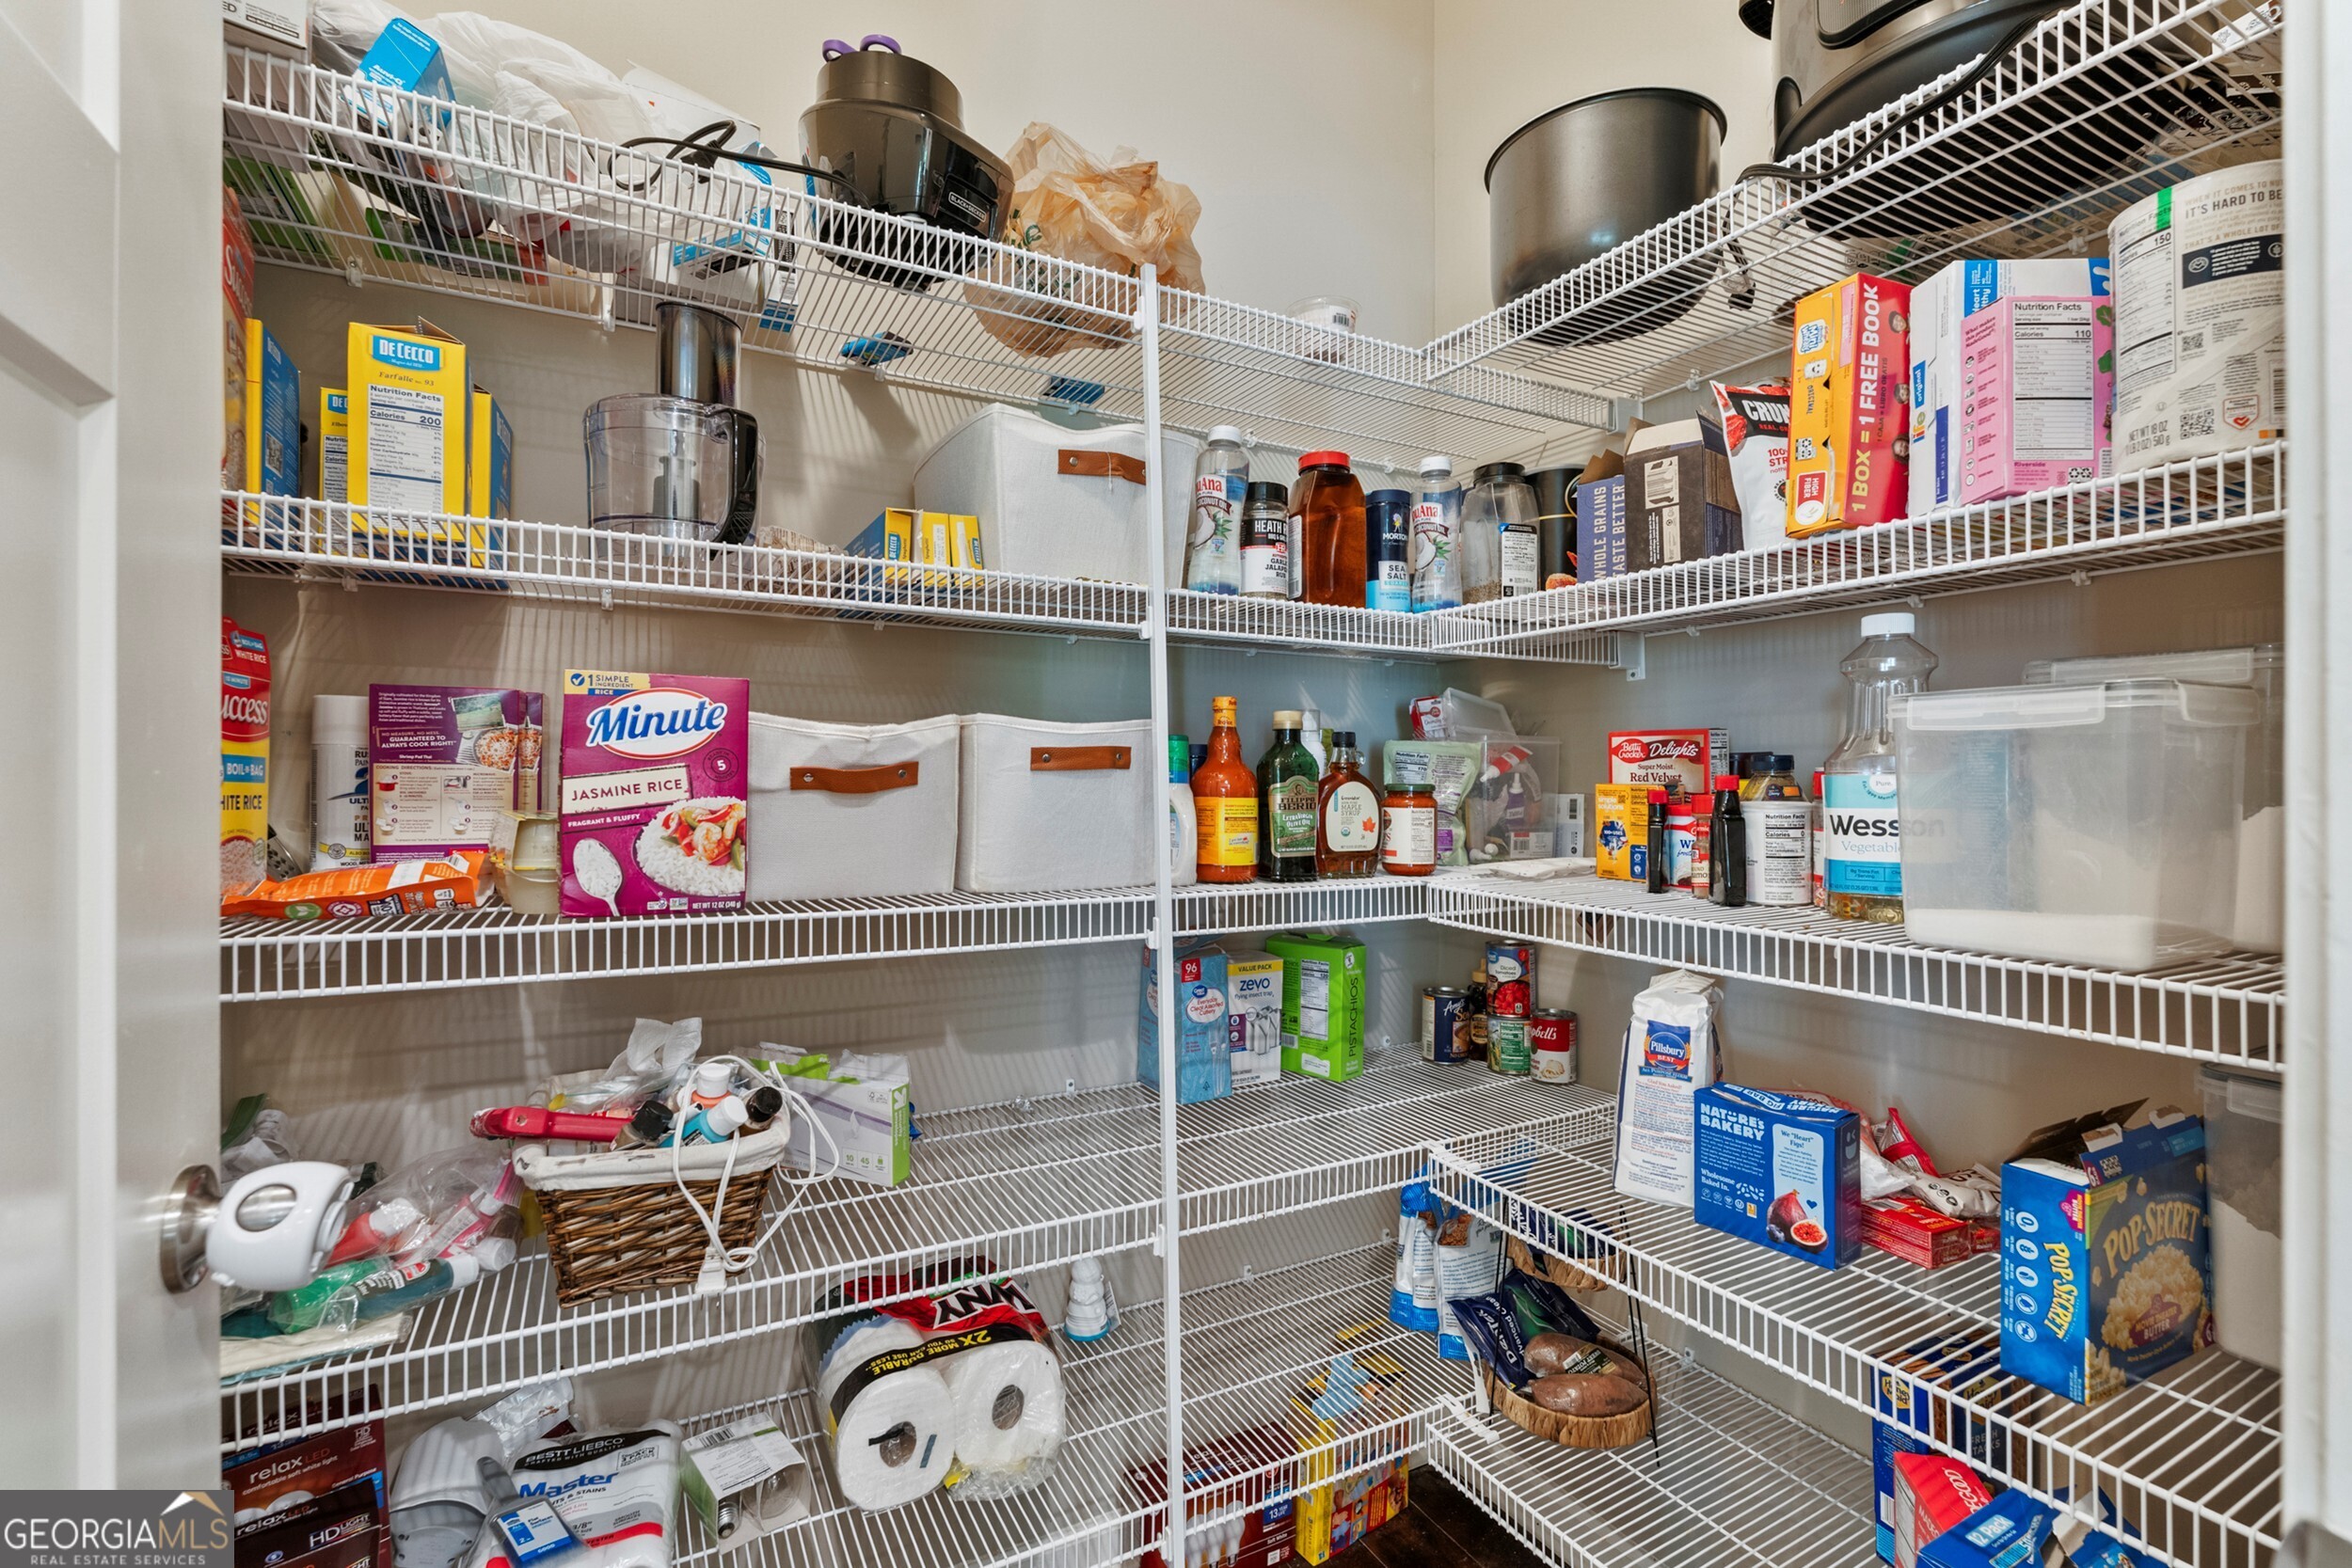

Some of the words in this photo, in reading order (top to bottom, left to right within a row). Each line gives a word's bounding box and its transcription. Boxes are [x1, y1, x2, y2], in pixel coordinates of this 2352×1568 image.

[2185, 193, 2210, 206] WHEN
[2214, 189, 2221, 198] IT
[2224, 182, 2256, 195] COMES
[2185, 203, 2208, 219] IT'S
[2213, 195, 2247, 211] HARD
[2250, 191, 2265, 203] TO
[2154, 232, 2171, 245] 150
[2185, 235, 2213, 249] THAT'S
[2223, 228, 2251, 238] WHOLE
[2254, 225, 2268, 233] LOT
[1862, 283, 1880, 347] BOOK
[379, 339, 395, 356] DE
[397, 341, 434, 364] CECCO
[379, 372, 413, 383] Farfalle
[1859, 352, 1879, 410] FREE
[370, 385, 412, 397] Nutrition
[416, 392, 441, 402] Facts
[1806, 384, 1815, 415] ORIGINAL
[370, 410, 405, 420] Calories
[420, 416, 441, 426] 200
[1858, 416, 1875, 425] 1
[2129, 428, 2138, 442] NET
[2140, 426, 2150, 439] WT
[2151, 423, 2156, 435] 18
[2158, 420, 2169, 433] OZ
[1851, 449, 1871, 497] BOX
[1594, 485, 1607, 534] GRAINS
[1613, 484, 1625, 534] BETTER
[1851, 503, 1867, 512] 1
[1255, 520, 1282, 533] HEATH
[1594, 537, 1607, 579] WHOLE
[588, 674, 594, 687] 1
[596, 674, 629, 683] SIMPLE
[590, 701, 724, 744] Minute
[1618, 749, 1645, 759] Crocker
[1621, 741, 1642, 753] Betty
[1649, 740, 1699, 760] Delights
[718, 760, 726, 771] 5
[1630, 772, 1649, 783] Red
[572, 784, 641, 800] JASMINE
[648, 779, 682, 793] RICE
[243, 795, 262, 810] RICE
[568, 817, 605, 828] FRAGRANT
[613, 813, 641, 822] FLUFFY
[1282, 813, 1297, 821] EXTRA
[1185, 962, 1198, 974] 96
[1239, 978, 1270, 991] zevo
[1197, 997, 1217, 1006] Everyday
[1444, 999, 1466, 1017] Amy's
[1348, 977, 1359, 1057] PISTACHIOS
[1651, 1040, 1684, 1057] Pillsbury
[1658, 1054, 1676, 1063] BEST
[1700, 1115, 1765, 1141] BAKERY
[1789, 1140, 1804, 1148] Figs!
[846, 1154, 854, 1163] 10
[860, 1157, 869, 1165] 45
[1701, 1168, 1735, 1185] Wholesome
[1701, 1176, 1720, 1189] Baked
[2144, 1319, 2170, 1340] BUTTER
[959, 1330, 992, 1346] 2X
[928, 1341, 960, 1355] MORE
[871, 1353, 925, 1375] DURABLE
[356, 1424, 371, 1438] HD
[526, 1449, 572, 1463] BESTT
[573, 1437, 622, 1454] LIEBCO
[249, 1456, 303, 1484] relax
[305, 1448, 331, 1464] LED
[524, 1457, 560, 1466] CRAFTED
[565, 1452, 585, 1461] WITH
[242, 1474, 287, 1496] comfortable
[288, 1469, 302, 1480] soft
[302, 1463, 321, 1475] white
[322, 1455, 339, 1467] light
[332, 1477, 354, 1489] General
[354, 1467, 377, 1481] Purpose
[519, 1472, 619, 1498] Master
[576, 1487, 606, 1497] STAINS
[236, 1513, 287, 1536] relax
[288, 1505, 310, 1517] LED
[530, 1514, 553, 1526] Surfaces
[612, 1513, 641, 1526] SURFACES
[615, 1510, 641, 1522] SMOOTH
[1268, 1508, 1279, 1519] 13
[309, 1525, 341, 1547] HD
[341, 1514, 370, 1529] LIGHT
[1276, 1532, 1288, 1542] White
[1971, 1533, 1989, 1547] 12
[1986, 1517, 2011, 1537] Pack
[537, 1544, 556, 1554] GOOD
